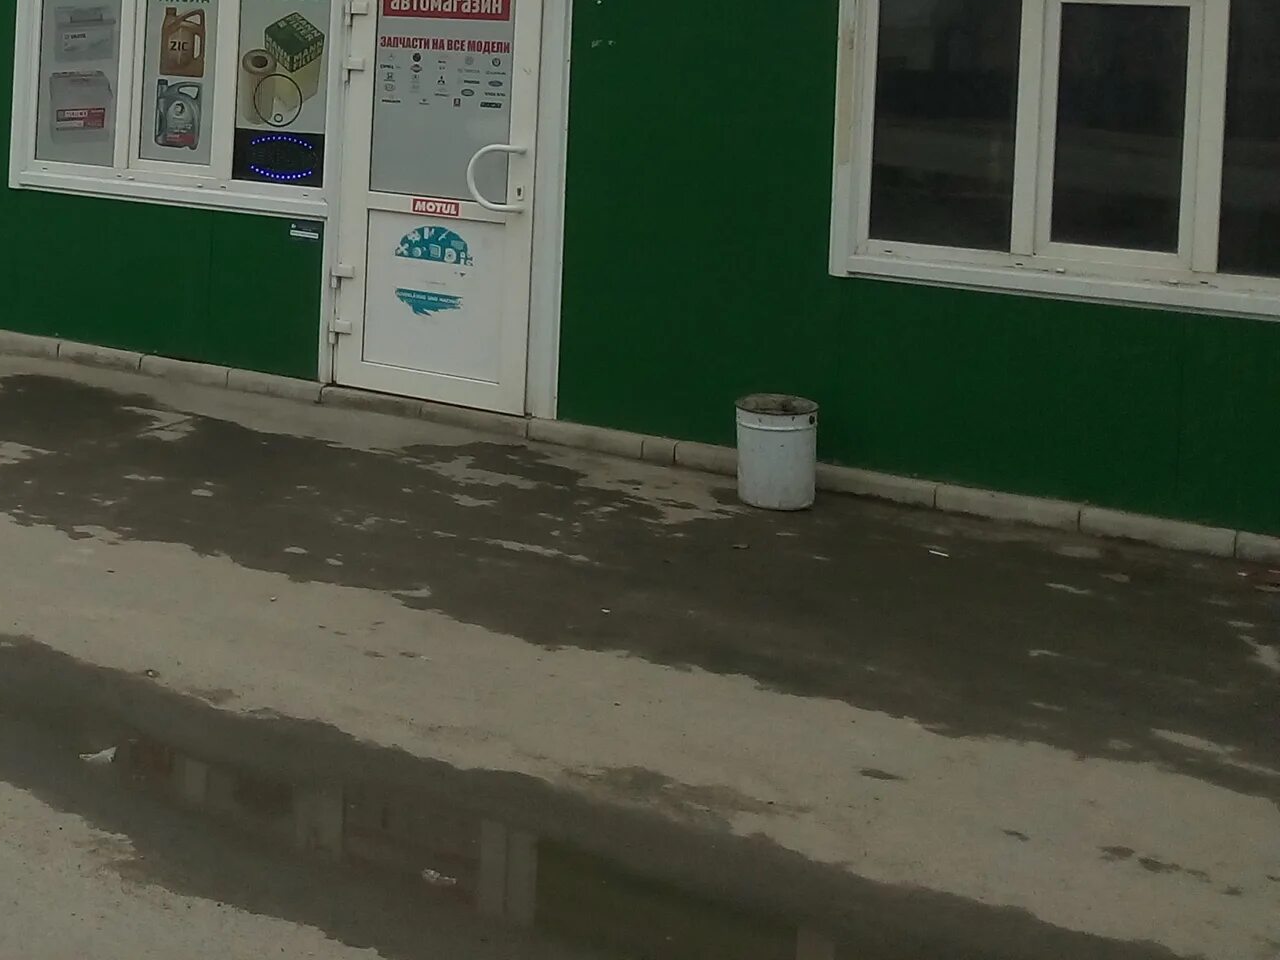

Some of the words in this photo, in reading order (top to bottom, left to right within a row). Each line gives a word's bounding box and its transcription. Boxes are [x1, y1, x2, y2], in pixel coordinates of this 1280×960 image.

[170, 41, 189, 51] ZIC
[380, 36, 430, 50] ЗАПЧАСТИ
[432, 38, 445, 50] НА
[447, 39, 465, 52] ВСЕ
[467, 40, 510, 54] МОДЕЛИ
[414, 200, 458, 215] MOTUL
